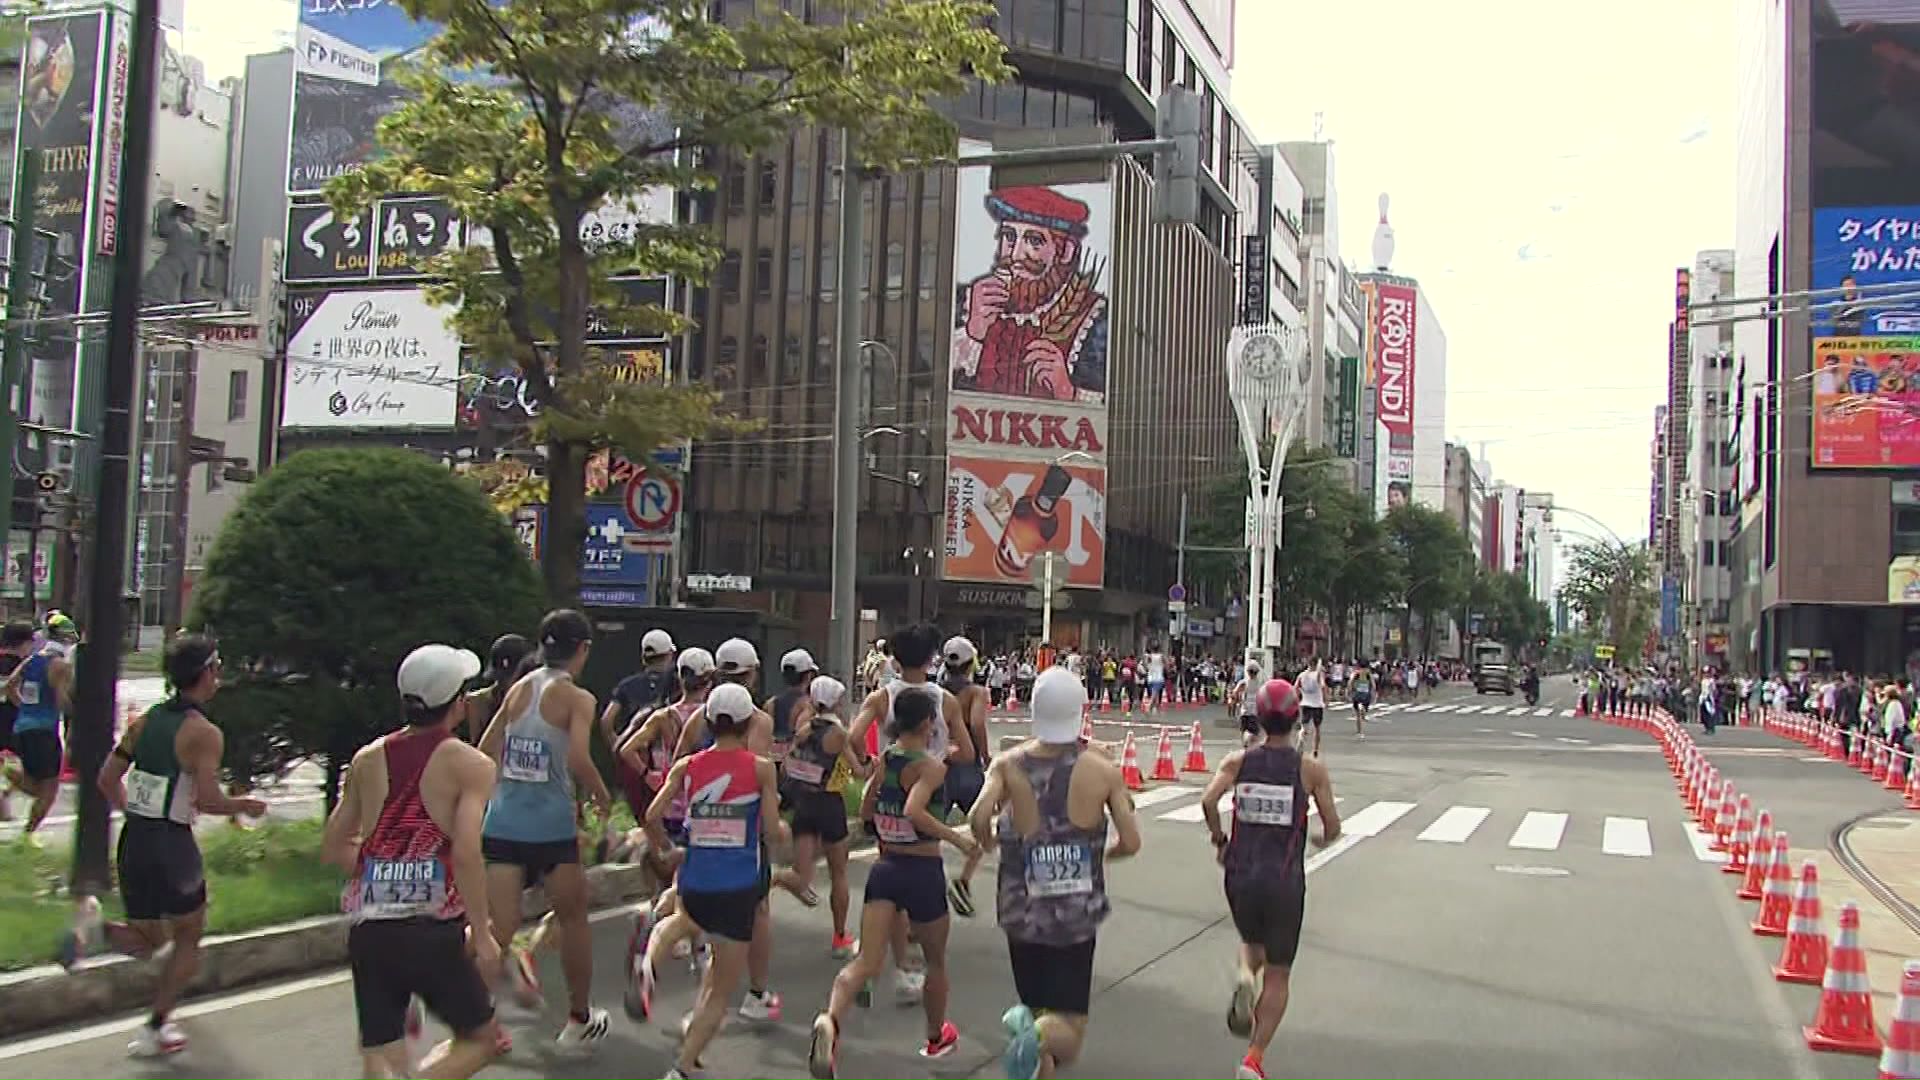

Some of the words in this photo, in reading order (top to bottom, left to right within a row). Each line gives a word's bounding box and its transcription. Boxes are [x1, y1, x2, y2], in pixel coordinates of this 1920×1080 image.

[330, 51, 377, 77] FIGHTERS
[302, 207, 436, 260] くろねこ
[335, 248, 407, 271] Lounge
[294, 298, 314, 317] 9F
[1381, 297, 1410, 424] ROUND1
[952, 405, 1103, 450] NIKKA
[961, 476, 977, 530] NIKKA
[958, 591, 1024, 605] SUSUKIN
[1048, 862, 1081, 881] 322
